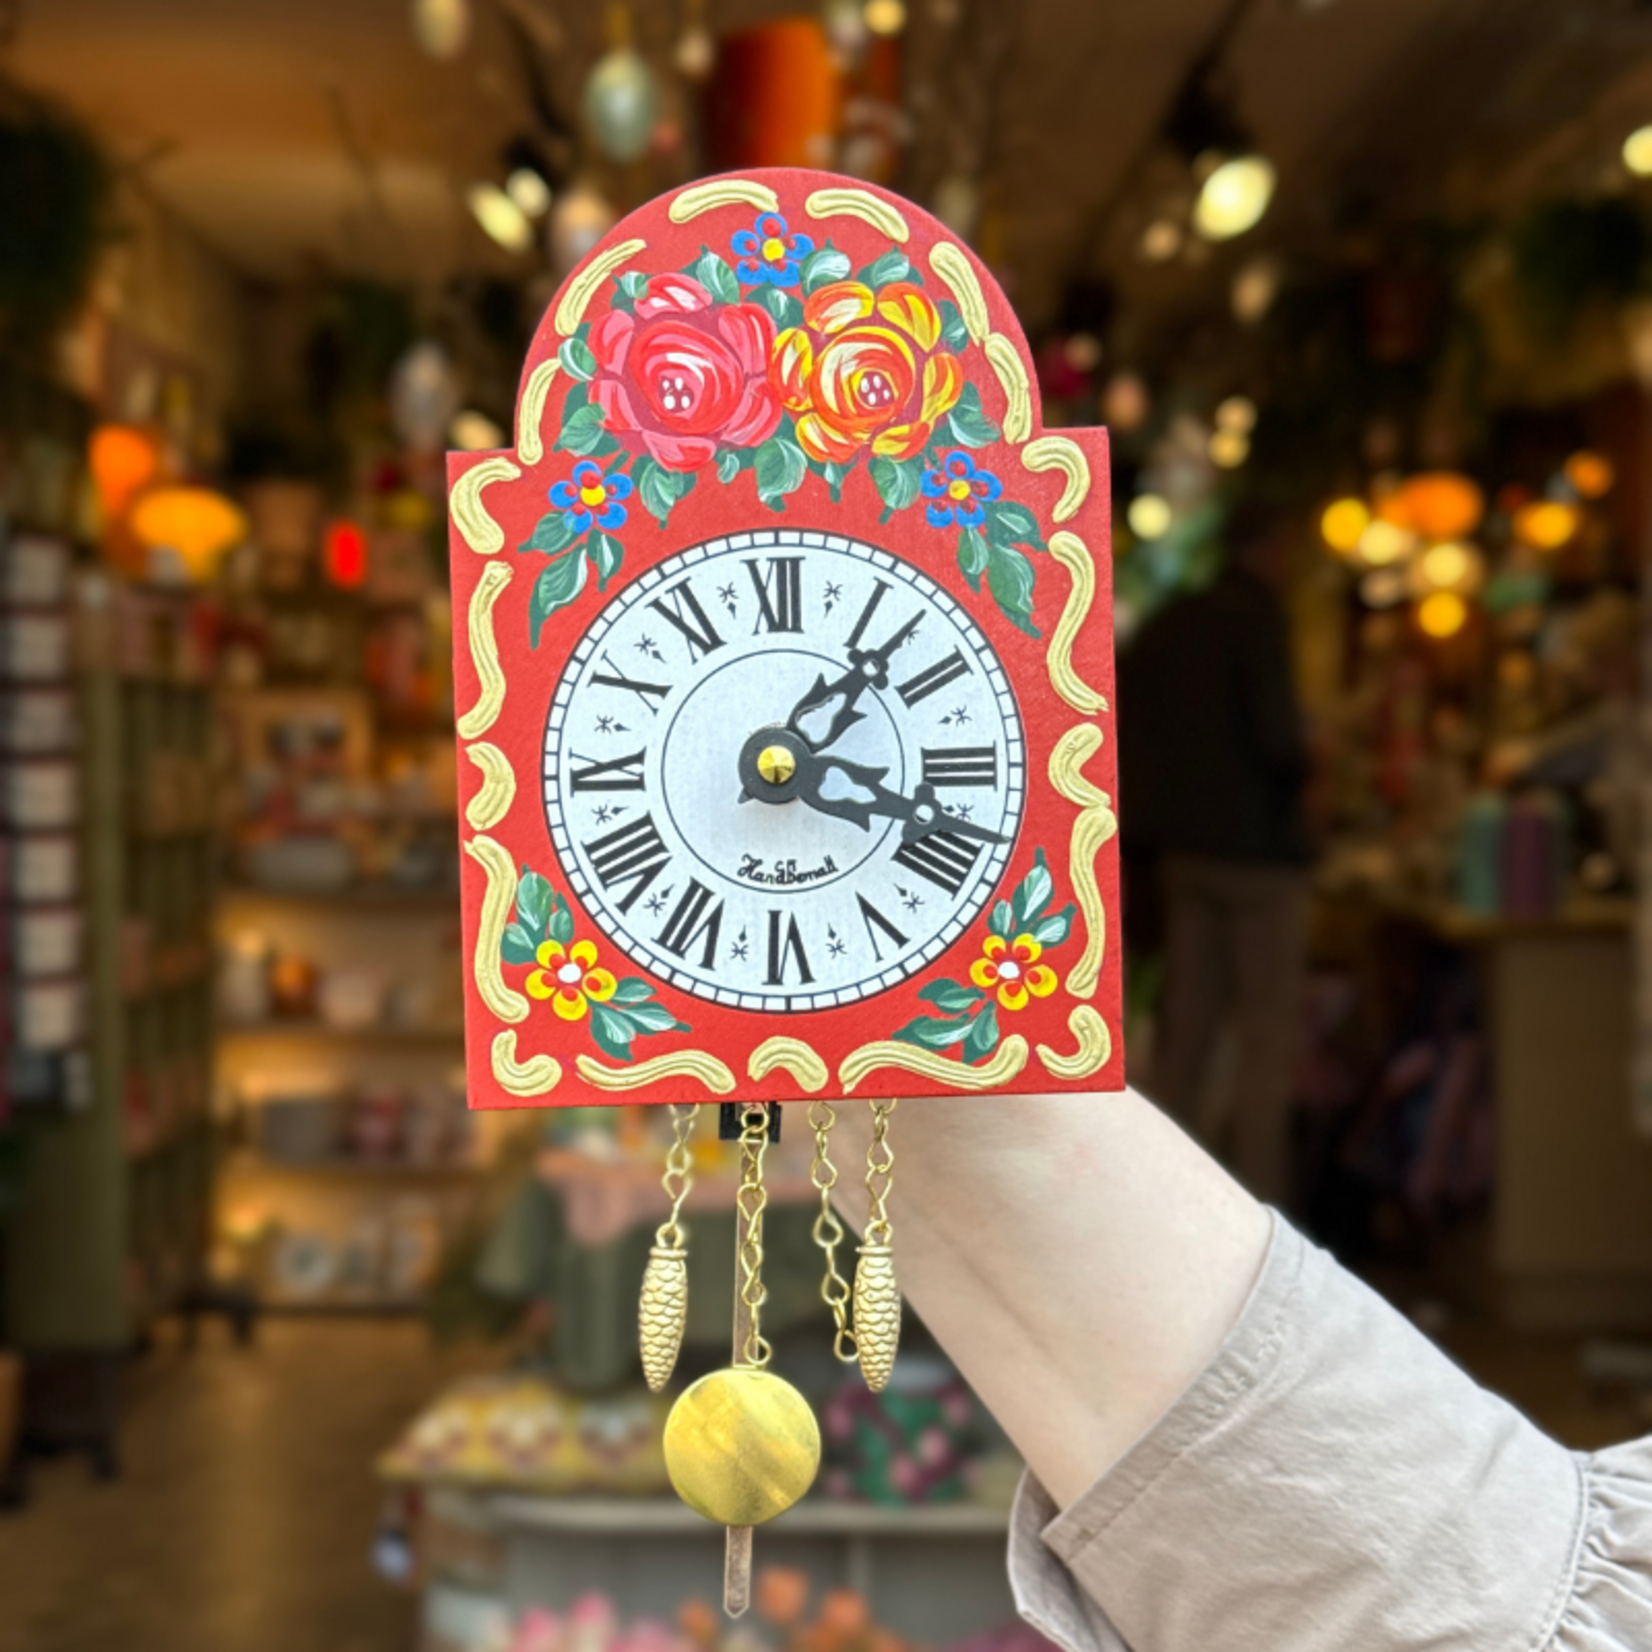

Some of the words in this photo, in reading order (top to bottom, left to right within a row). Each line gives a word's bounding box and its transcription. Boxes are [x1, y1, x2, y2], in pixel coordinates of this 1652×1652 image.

[645, 576, 728, 664] XI
[741, 556, 806, 635] XII
[842, 576, 895, 648] I
[587, 651, 673, 716] X
[894, 644, 974, 710] II
[568, 746, 647, 798] IX
[920, 740, 998, 792] III
[581, 811, 673, 916] VIII
[890, 828, 986, 902] IIII
[651, 876, 725, 971] VII
[761, 909, 816, 986] VI
[855, 891, 911, 962] V
